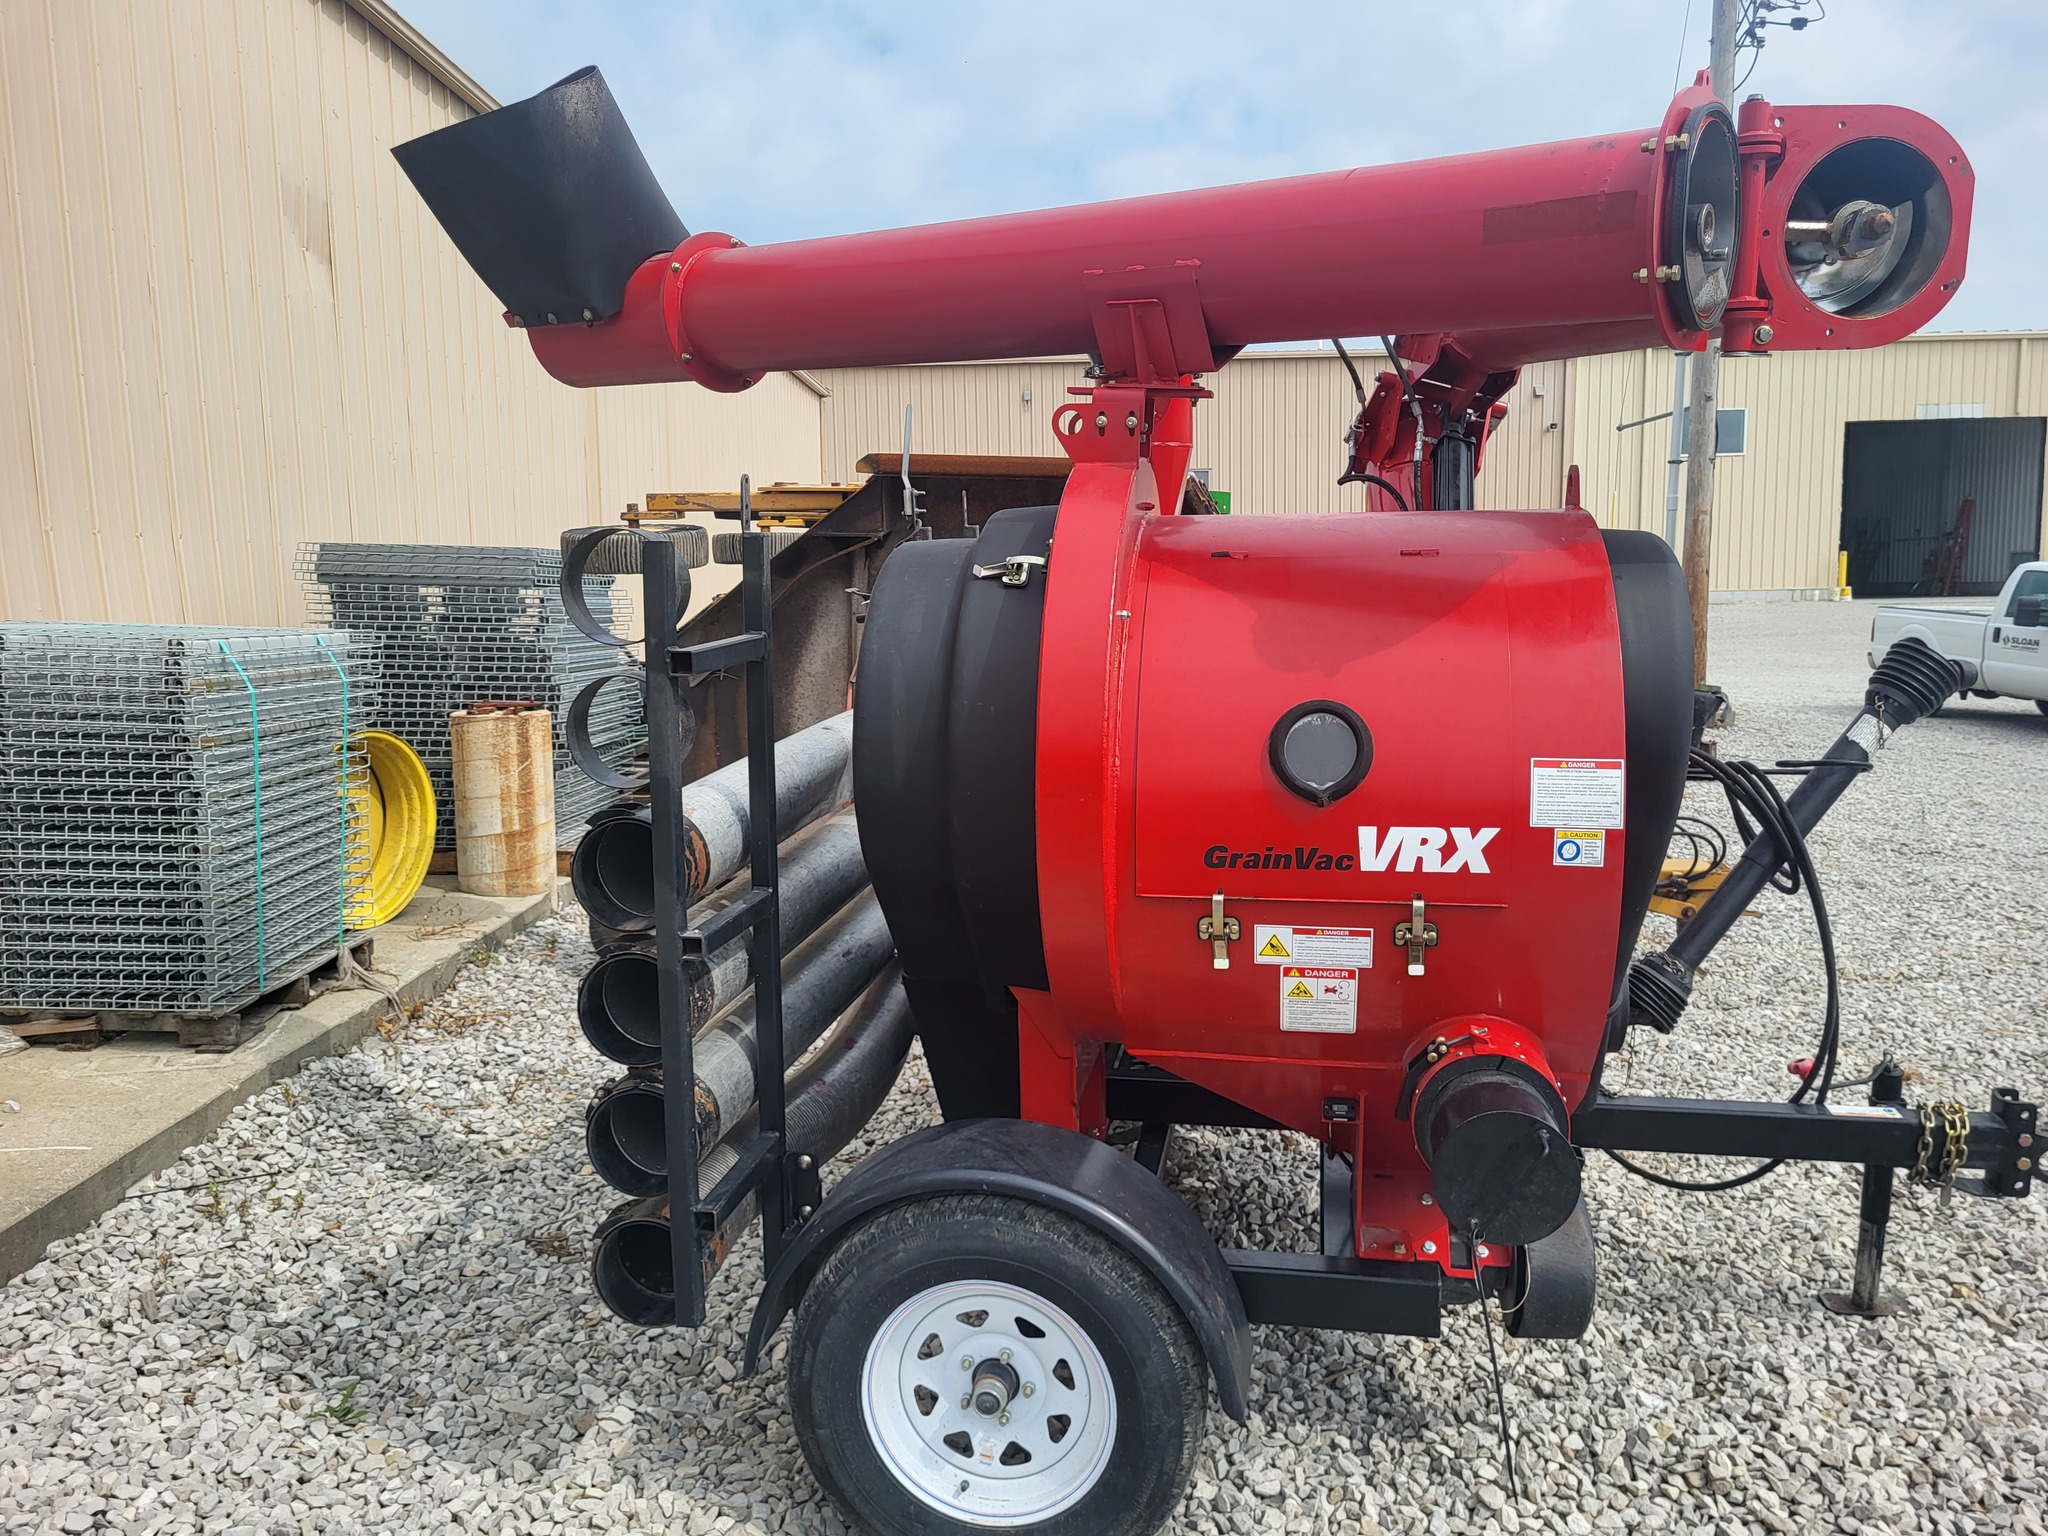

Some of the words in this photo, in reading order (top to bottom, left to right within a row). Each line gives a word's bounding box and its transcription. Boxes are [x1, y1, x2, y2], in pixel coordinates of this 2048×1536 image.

[2010, 637, 2040, 647] SLOAN
[1203, 845, 1355, 871] GrainVac
[1357, 826, 1502, 874] VRX
[1304, 969, 1349, 978] DANGER
